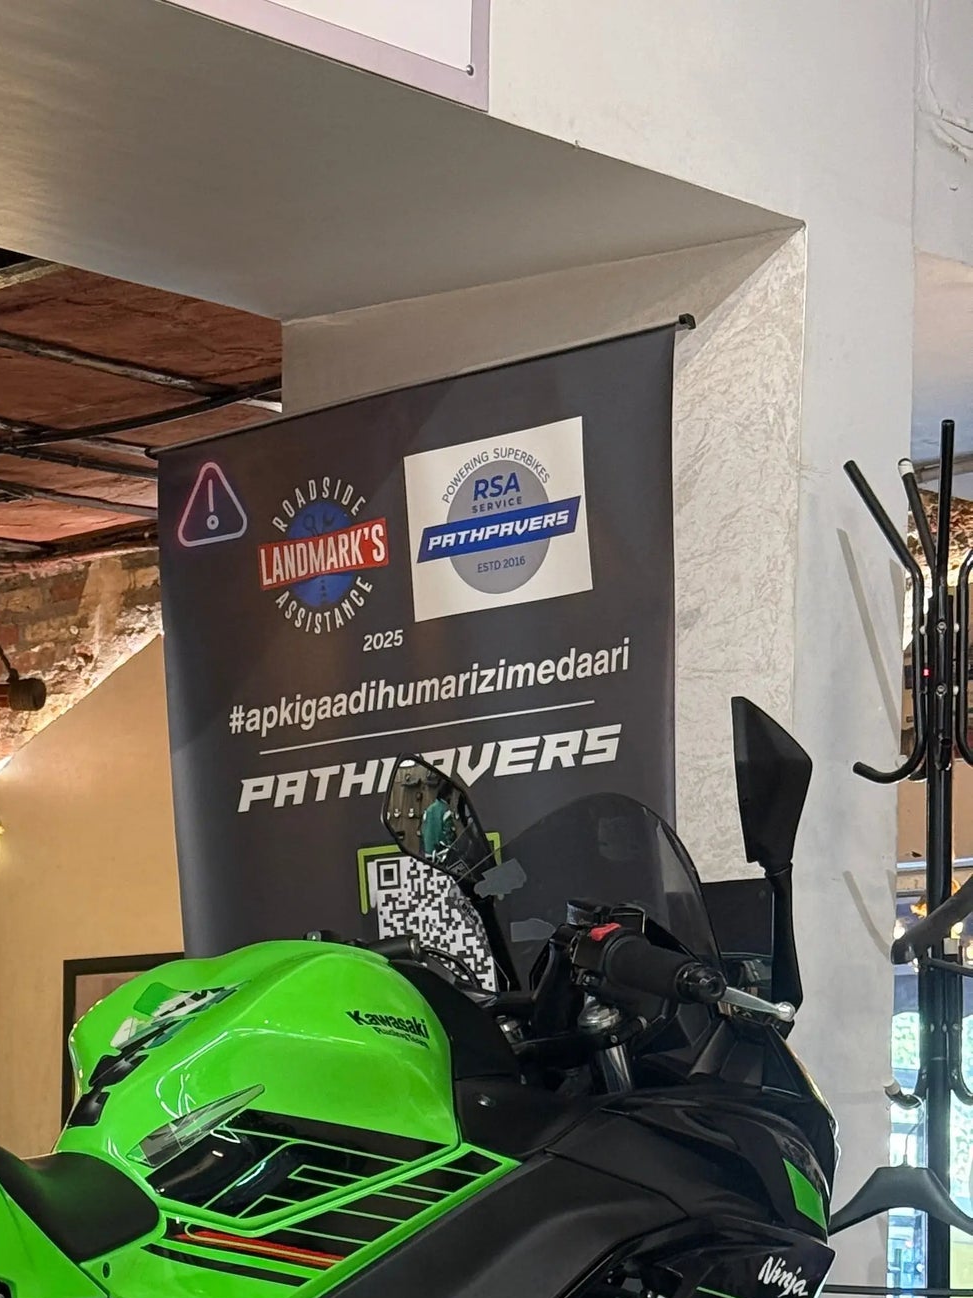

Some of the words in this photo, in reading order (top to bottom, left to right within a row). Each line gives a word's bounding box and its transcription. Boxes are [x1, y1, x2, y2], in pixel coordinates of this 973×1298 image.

[442, 451, 489, 504] POWERING
[493, 447, 551, 485] SUPERBIKES
[473, 472, 521, 501] RSA
[272, 476, 366, 532] ROADSIDE
[471, 496, 523, 514] SERVICE
[428, 509, 570, 551] PATHPAVERS
[260, 523, 386, 586] LANDMARK'S
[477, 558, 501, 573] ESTD
[502, 555, 526, 569] 2016
[275, 576, 373, 634] ASSISTANCE
[363, 629, 403, 652] 2025
[229, 638, 630, 738] #apkigaadihumarizimedaari
[345, 1010, 430, 1040] Kawasaki
[758, 1256, 808, 1298] Ninja
